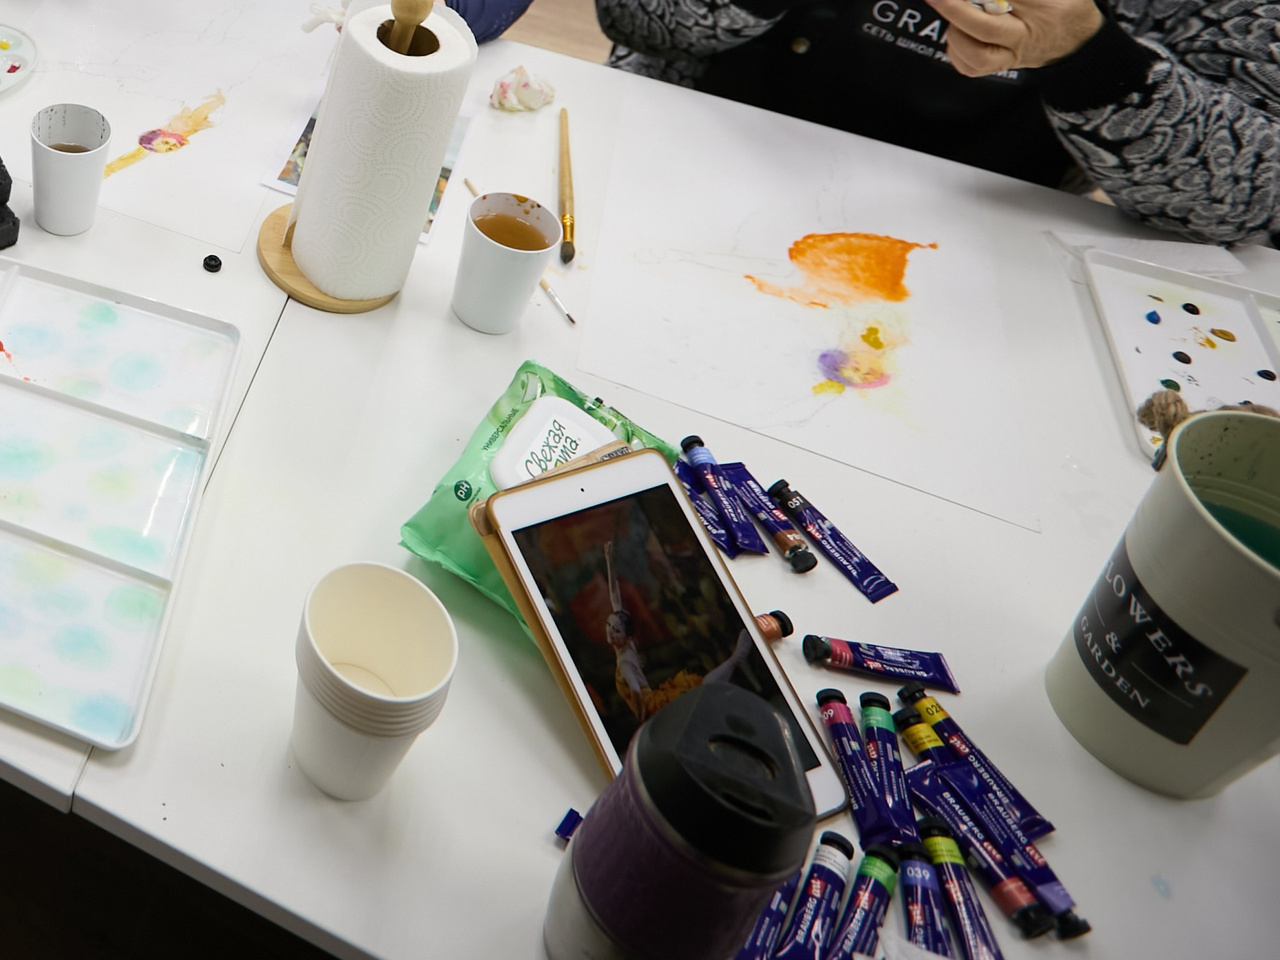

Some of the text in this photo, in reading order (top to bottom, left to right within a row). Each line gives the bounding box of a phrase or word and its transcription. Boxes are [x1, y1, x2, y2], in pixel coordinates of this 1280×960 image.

[862, 22, 895, 43] СЕТЬ
[872, 0, 948, 44] GRA
[481, 407, 520, 451] УНИВЕРСАЛЬНЫЕ
[457, 482, 471, 500] pH
[787, 496, 805, 509] 051
[1104, 561, 1213, 698] LOWERS
[1105, 631, 1122, 655] &
[1080, 615, 1151, 709] GARDEN
[968, 754, 1011, 805] BRAUBERG
[942, 790, 986, 841] BRAUBERG
[987, 792, 1028, 845] BRAUBERG
[906, 866, 931, 881] 039
[796, 898, 818, 944] BRAUBERG
